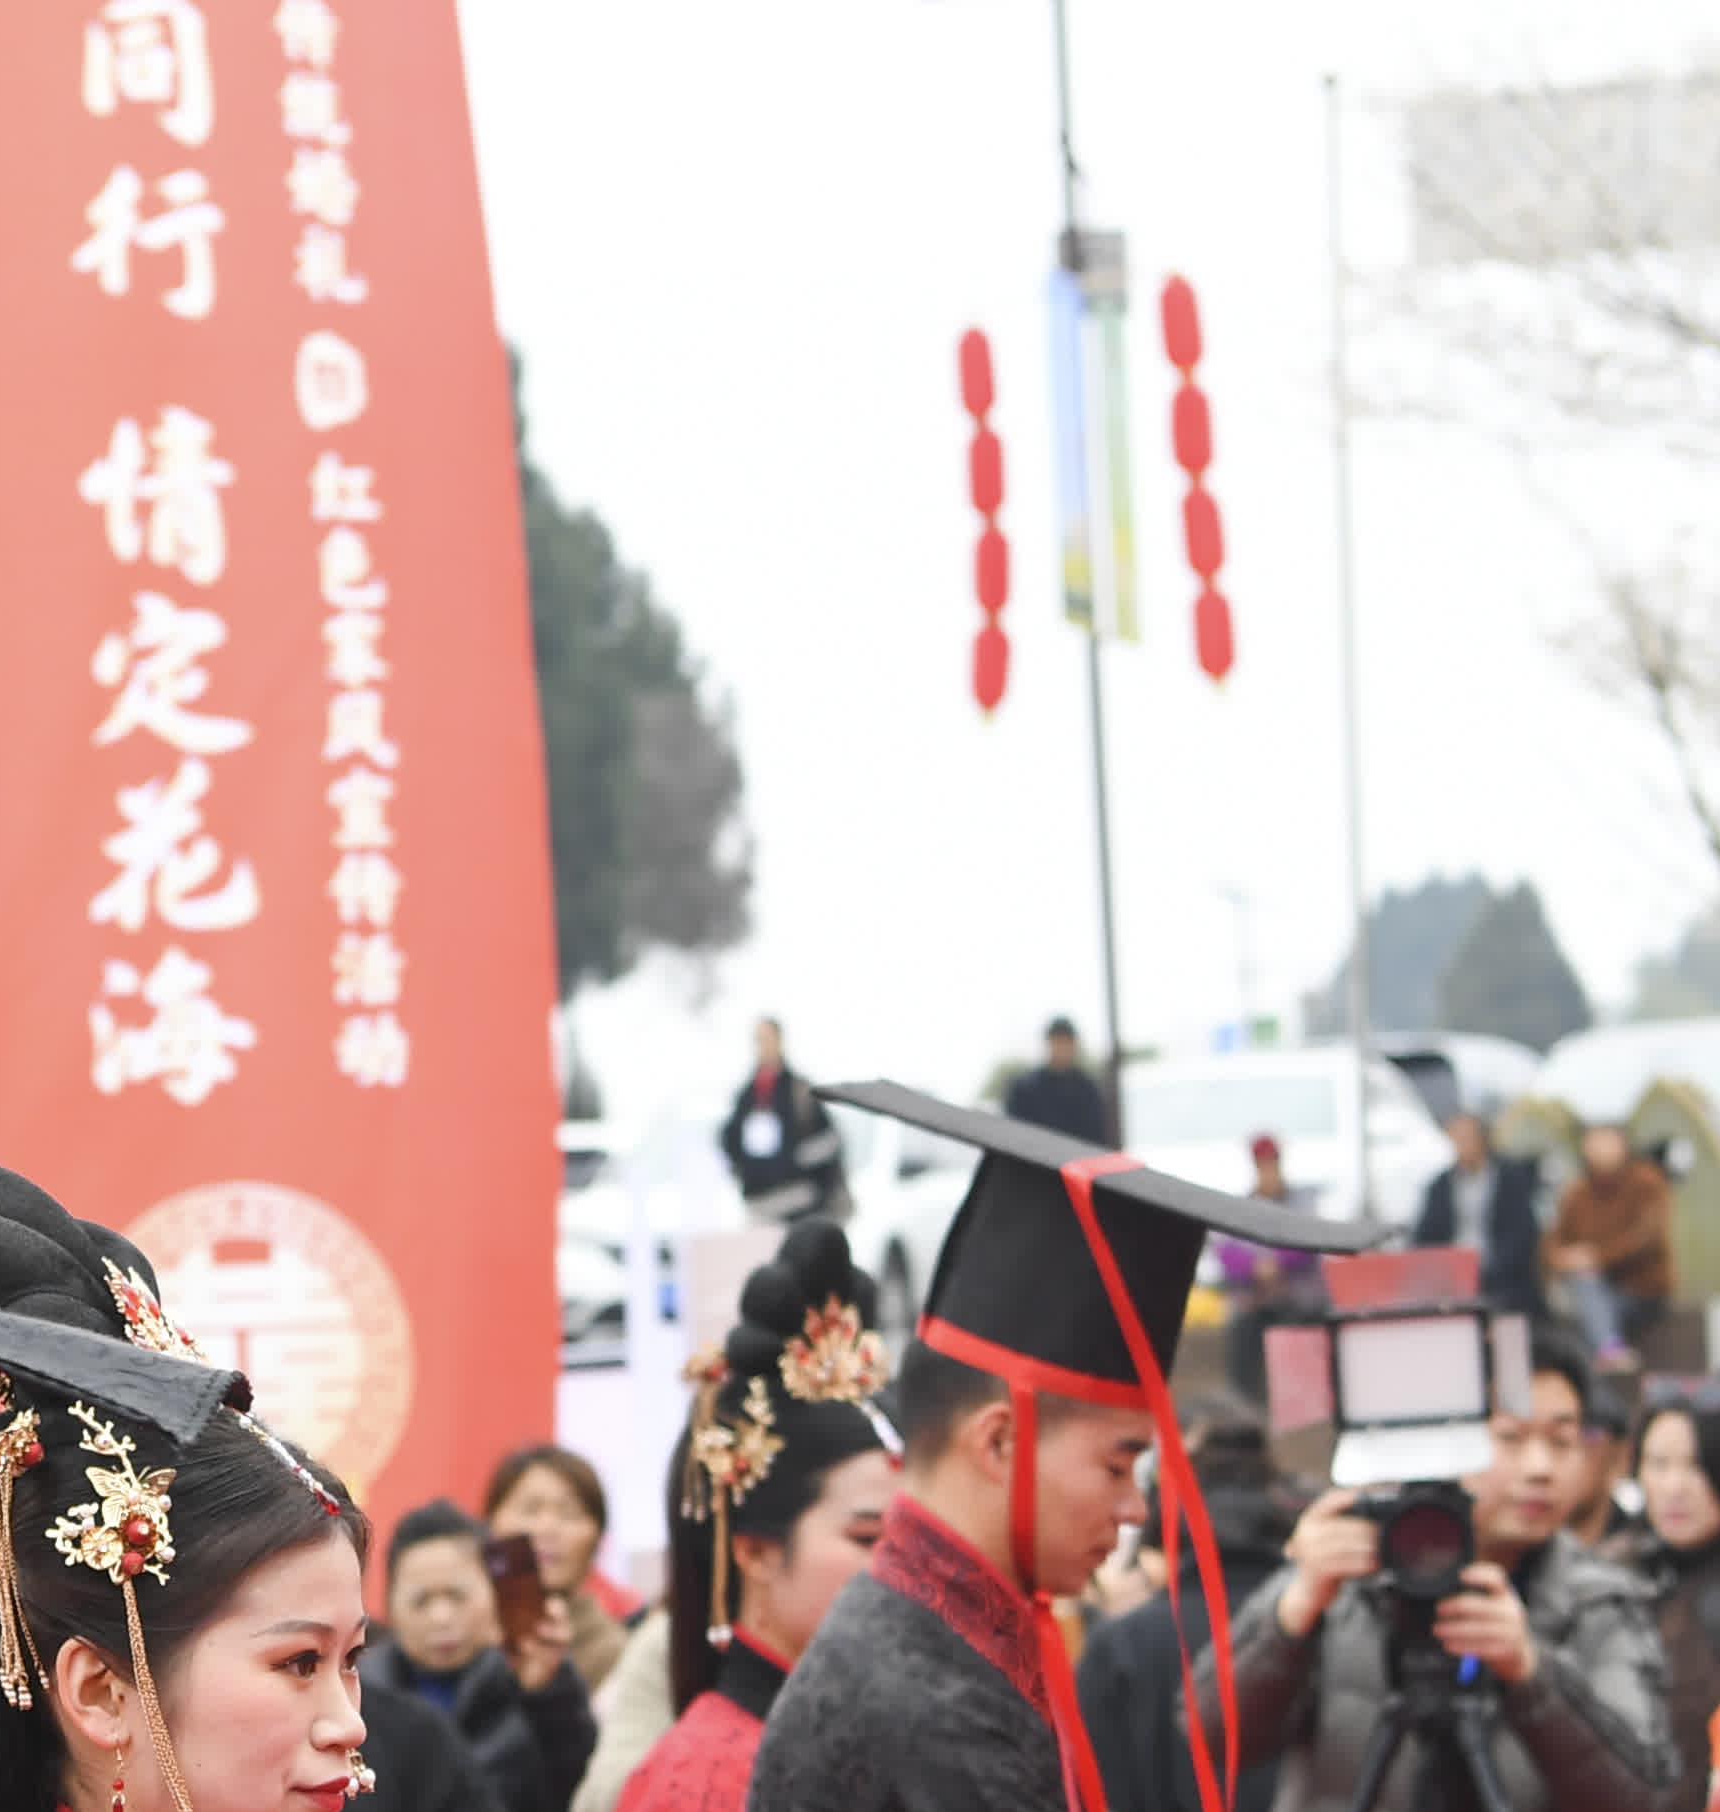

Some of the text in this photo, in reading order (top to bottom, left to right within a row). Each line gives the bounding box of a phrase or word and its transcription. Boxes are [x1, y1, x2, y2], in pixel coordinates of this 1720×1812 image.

[72, 0, 259, 1106] 同行 情定花海
